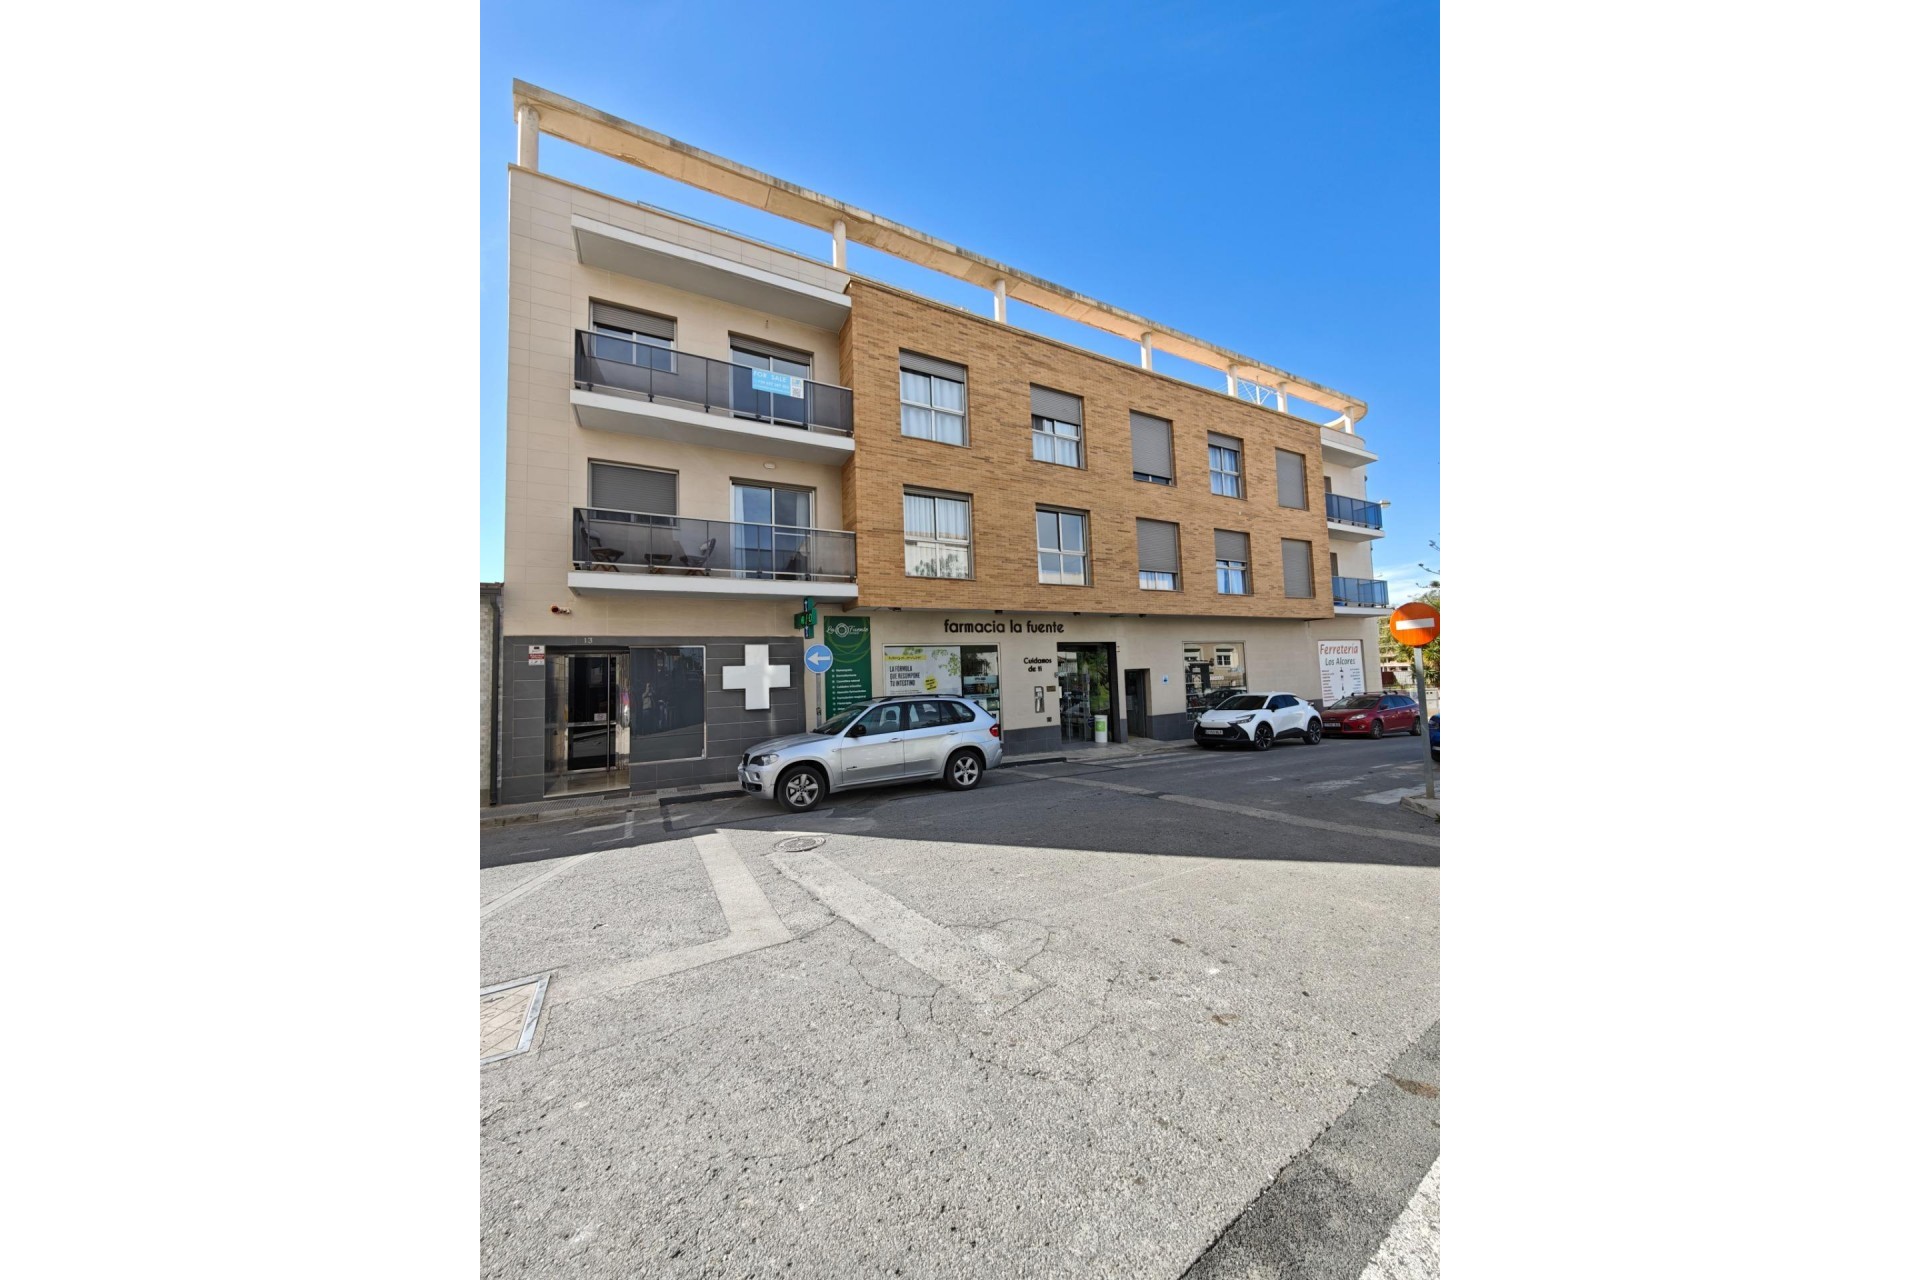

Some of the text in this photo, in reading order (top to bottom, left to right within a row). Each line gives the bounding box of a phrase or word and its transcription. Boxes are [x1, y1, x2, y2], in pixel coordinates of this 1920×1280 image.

[771, 374, 786, 383] SALE
[944, 619, 1065, 633] farmacia la fuente
[1325, 658, 1335, 666] Los
